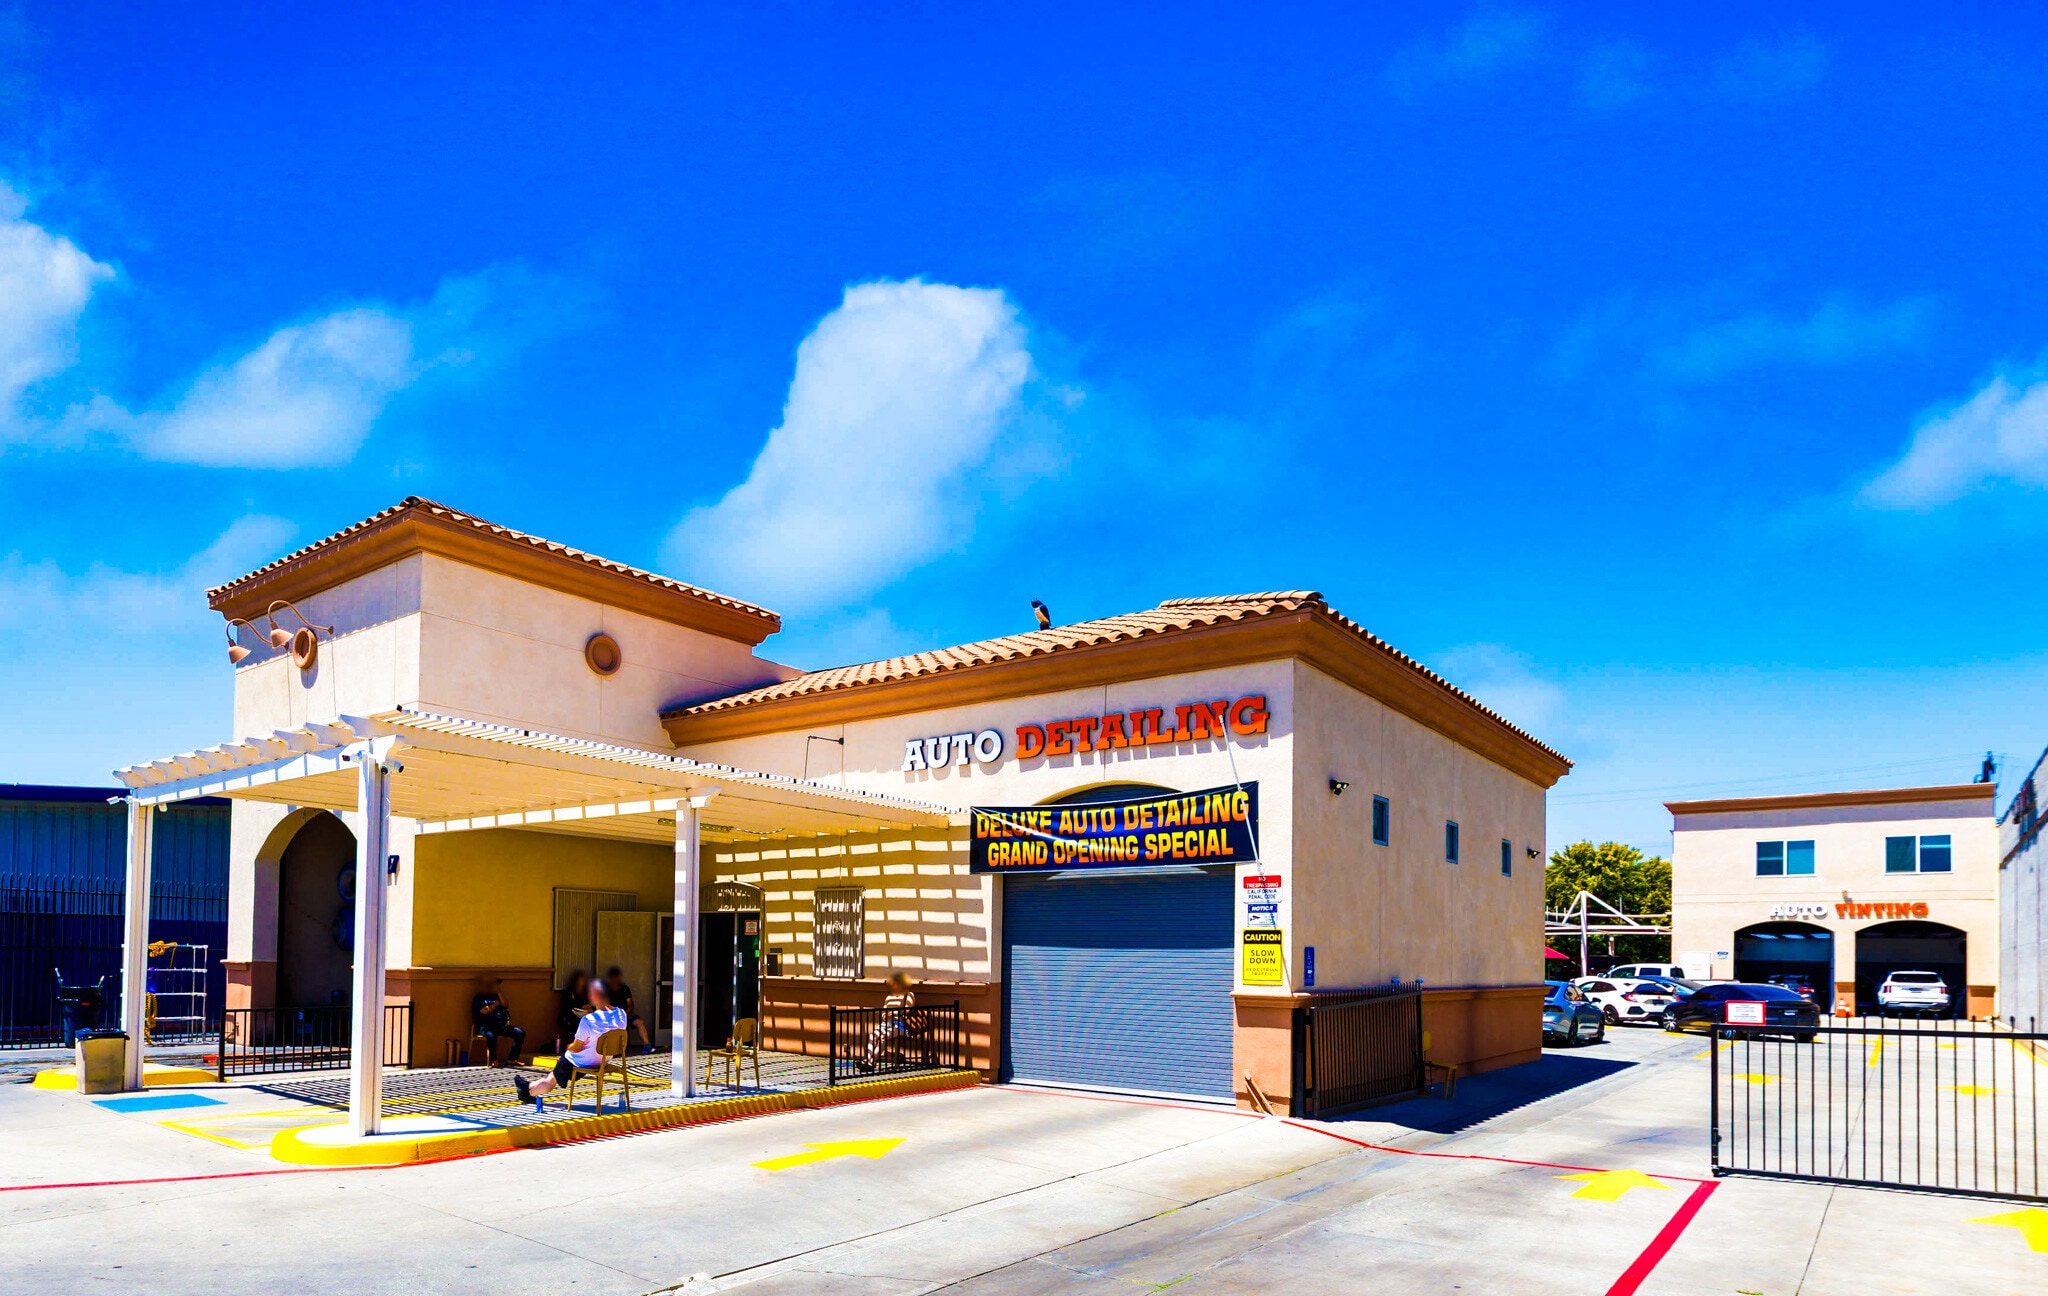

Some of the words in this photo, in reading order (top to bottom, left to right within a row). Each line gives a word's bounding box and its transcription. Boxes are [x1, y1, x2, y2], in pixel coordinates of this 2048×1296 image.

[901, 730, 1003, 772] AUTO
[1015, 695, 1270, 760] DETAILING
[976, 809, 1052, 839] DELUXE
[1060, 807, 1115, 835] AUTO
[1123, 791, 1250, 831] DETAILING
[988, 841, 1048, 867] GRAND
[1053, 836, 1139, 864] OPENING
[1145, 829, 1233, 860] SPECIAL
[1770, 903, 1828, 918] AUTO
[1835, 902, 1929, 917] TINTING
[1244, 933, 1281, 941] CAUTION
